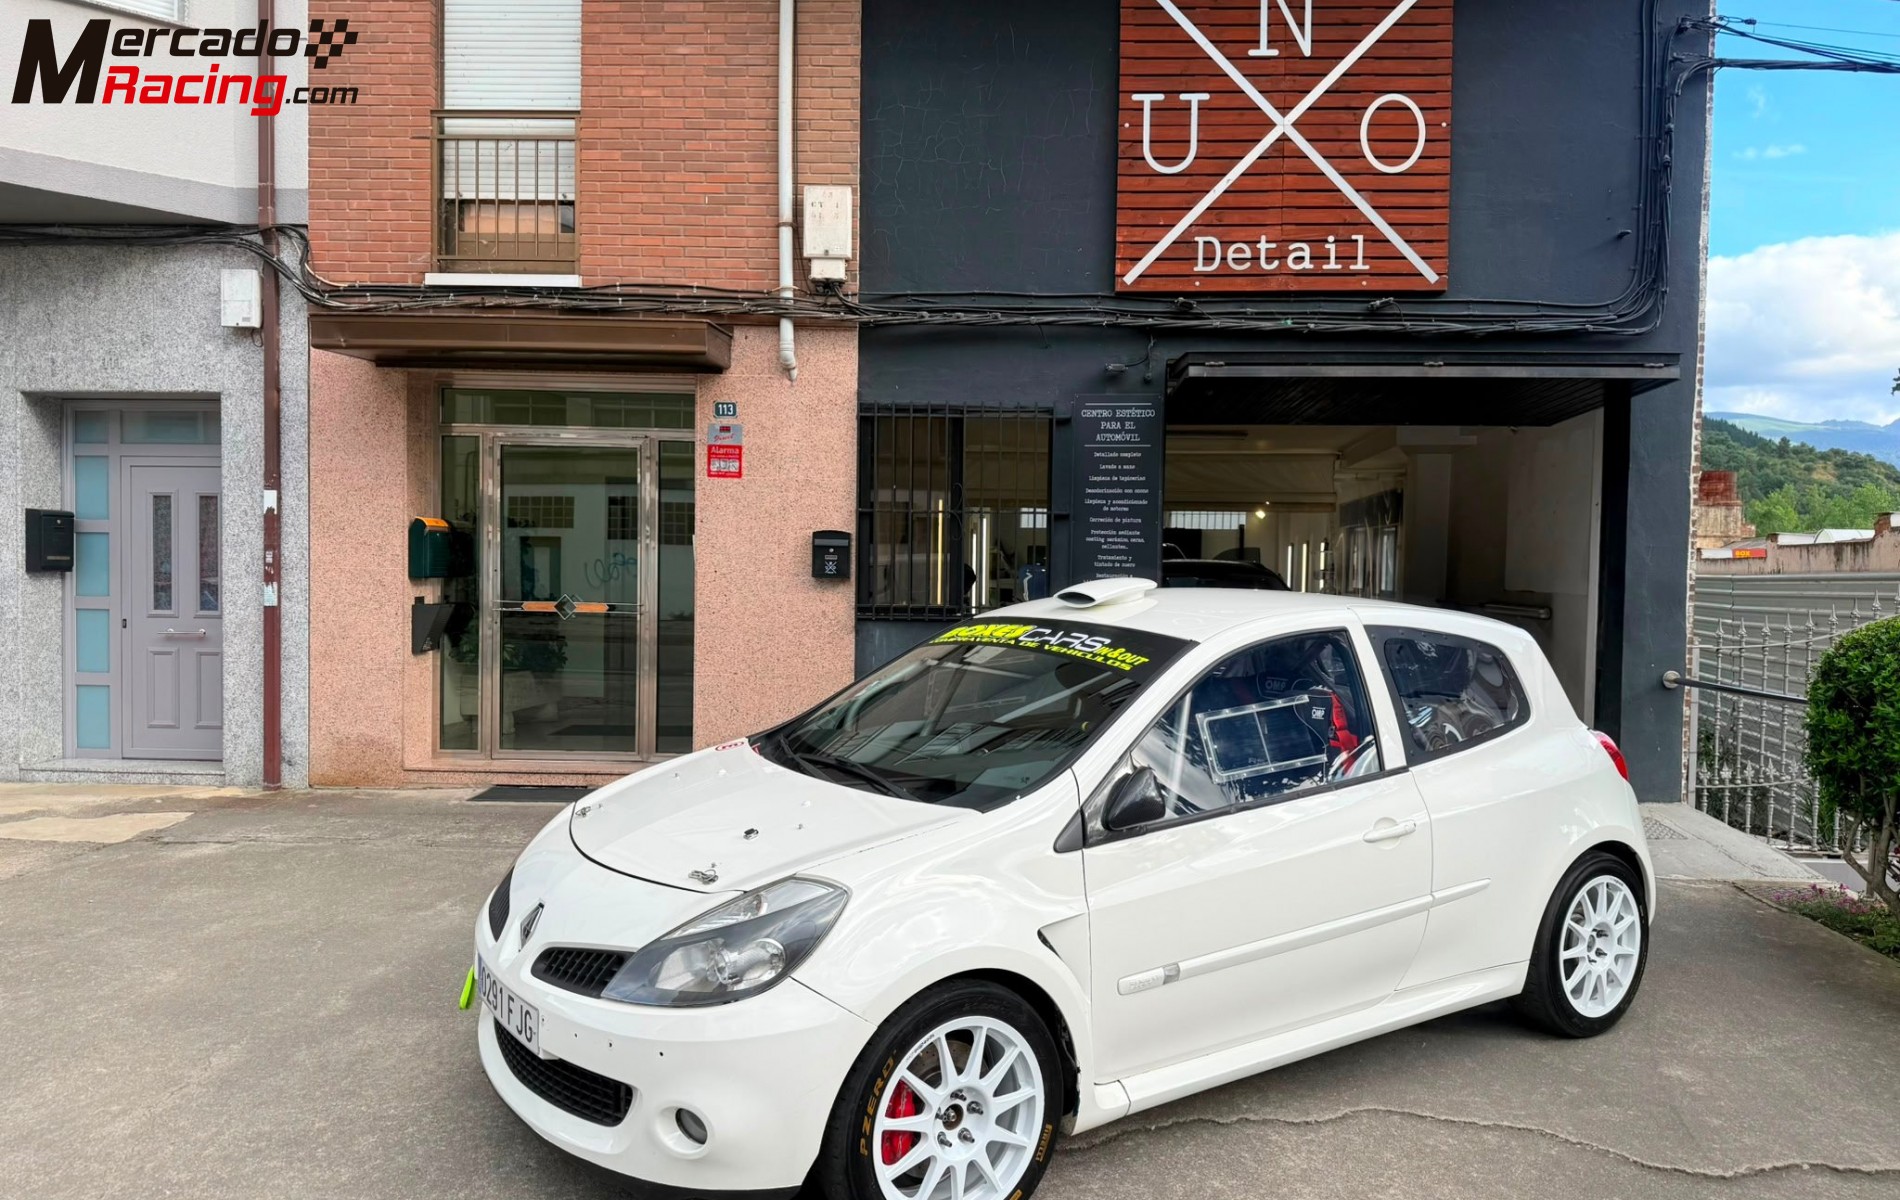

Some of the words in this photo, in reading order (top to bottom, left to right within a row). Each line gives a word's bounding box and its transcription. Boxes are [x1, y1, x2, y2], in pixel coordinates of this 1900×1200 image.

[1193, 235, 1370, 272] Detail
[718, 403, 734, 415] 113
[1081, 409, 1113, 418] CENTRO
[1115, 407, 1156, 418] ESTÉTICO
[1100, 421, 1121, 430] PARA
[1124, 421, 1136, 430] EL
[1095, 431, 1141, 442] AUTOMÓVIL
[710, 446, 740, 454] Alarma
[1018, 640, 1041, 648] DE
[1044, 644, 1134, 671] VEHICULOS
[481, 965, 504, 1019] 0291
